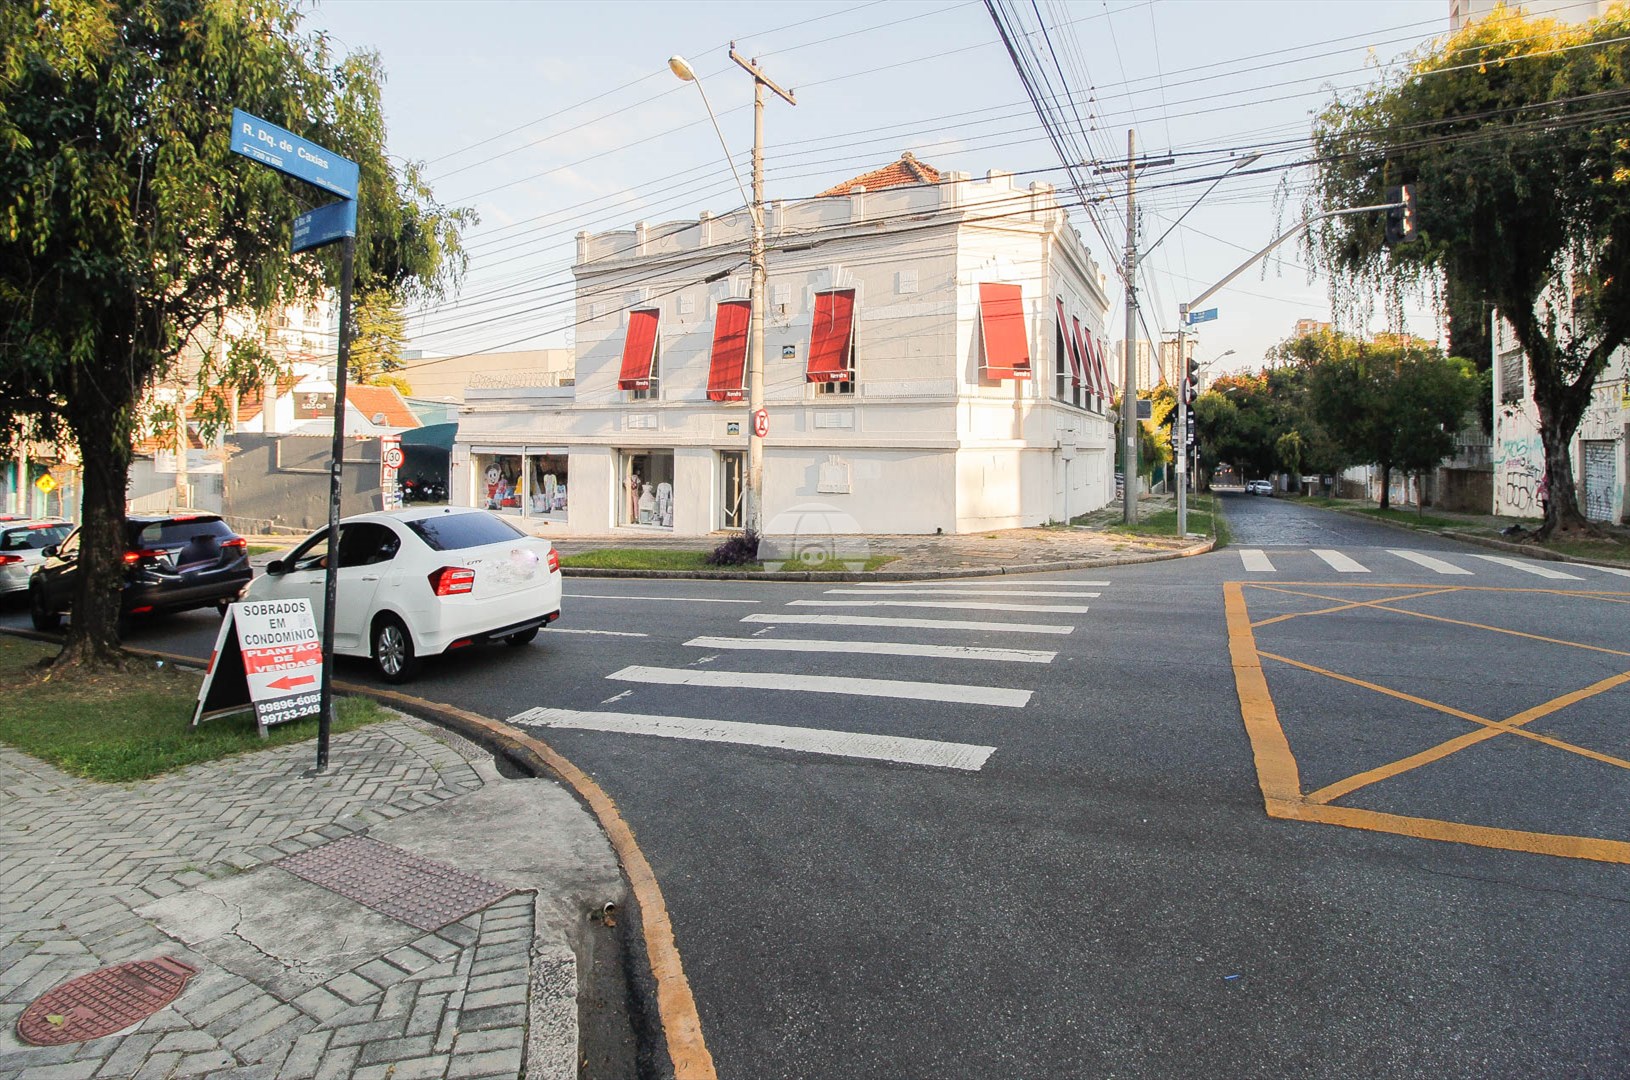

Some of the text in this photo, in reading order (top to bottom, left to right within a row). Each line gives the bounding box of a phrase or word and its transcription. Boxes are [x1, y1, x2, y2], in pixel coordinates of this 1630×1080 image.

[242, 122, 329, 169] R. Dq. de Caxias
[388, 452, 400, 462] 30
[243, 602, 306, 617] SOBRADOS
[270, 617, 286, 629] EM
[245, 628, 315, 645] CONDOMÍNIO
[247, 643, 319, 657] PLANTÃO
[256, 658, 318, 673] VENDAS
[273, 654, 295, 663] DE
[261, 705, 320, 724] 99733-248
